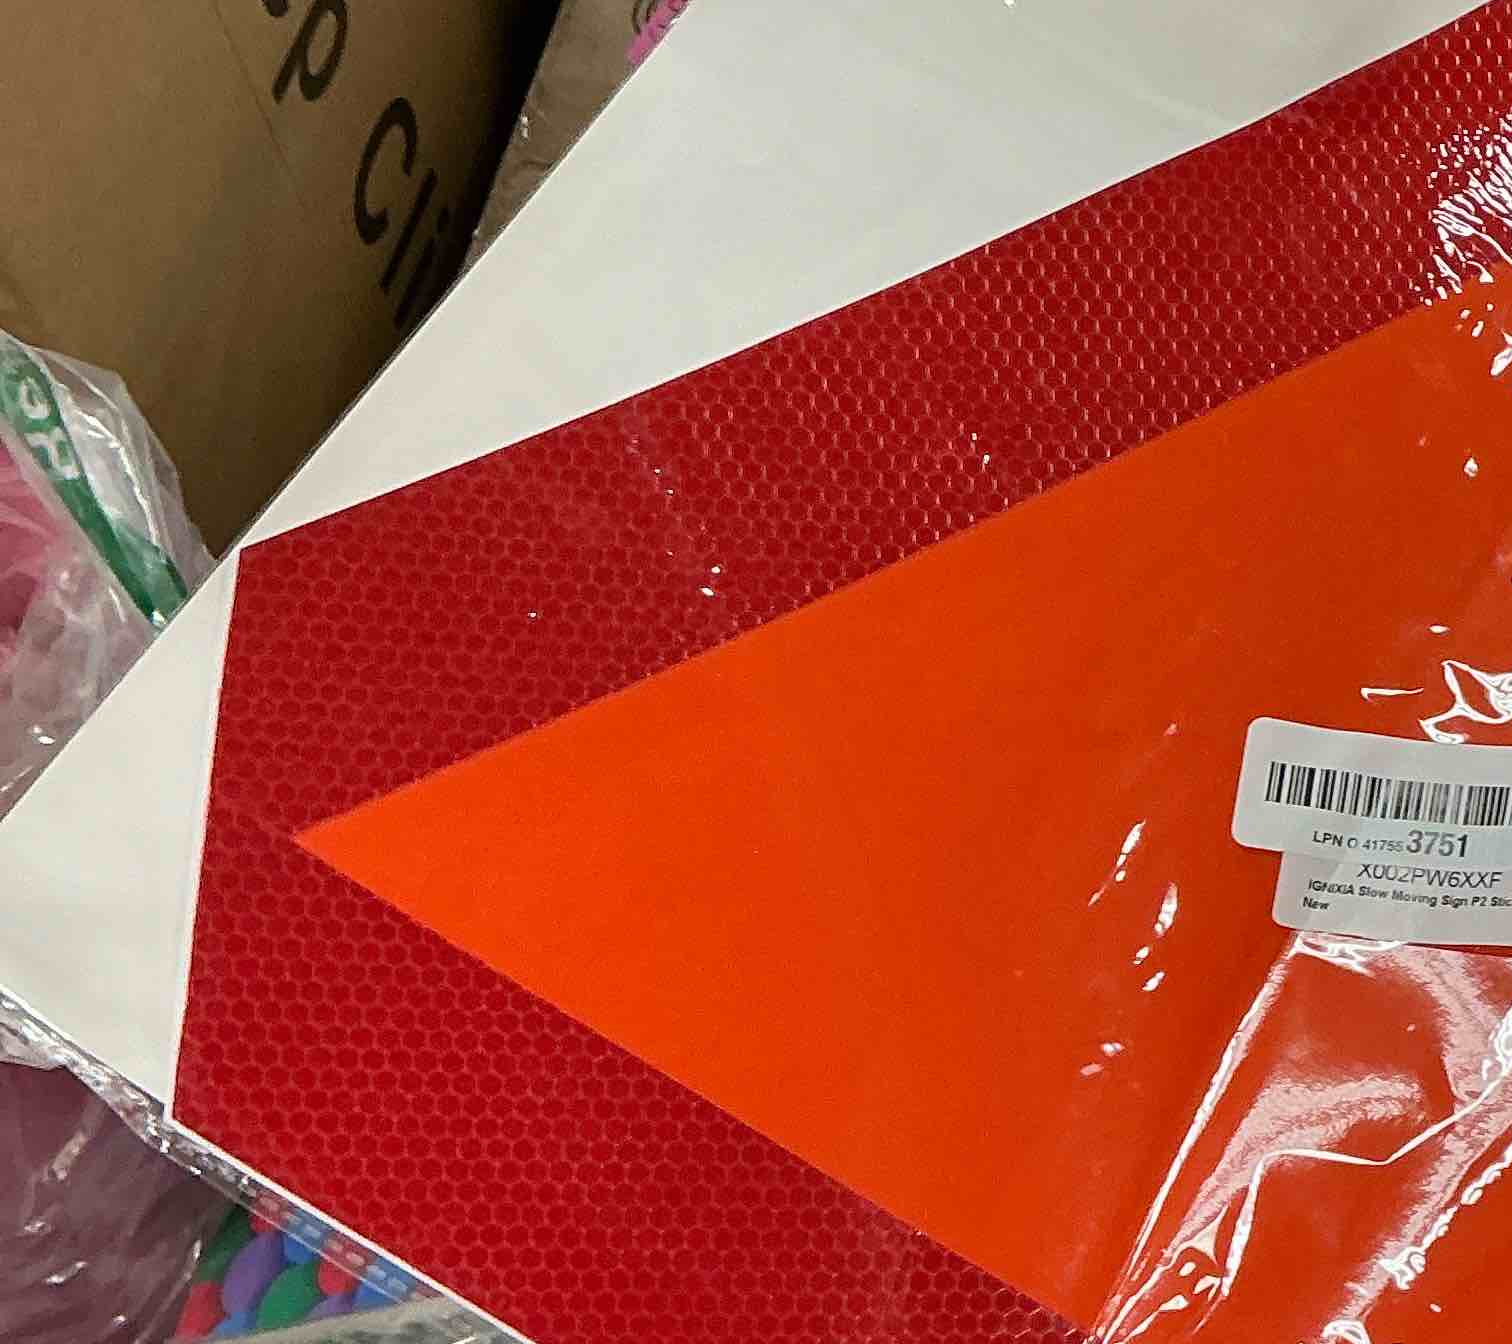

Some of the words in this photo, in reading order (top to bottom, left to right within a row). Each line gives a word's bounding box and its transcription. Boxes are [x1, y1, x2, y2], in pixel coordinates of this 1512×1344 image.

[1311, 830, 1344, 848] LPN
[1406, 829, 1468, 858] 3751
[1356, 862, 1504, 889] X002PW6XXF
[1301, 895, 1331, 911] New
[1358, 885, 1388, 899] Slow
[1391, 889, 1439, 908] Moving
[1440, 894, 1469, 909] Sign
[1471, 896, 1489, 908] P2
